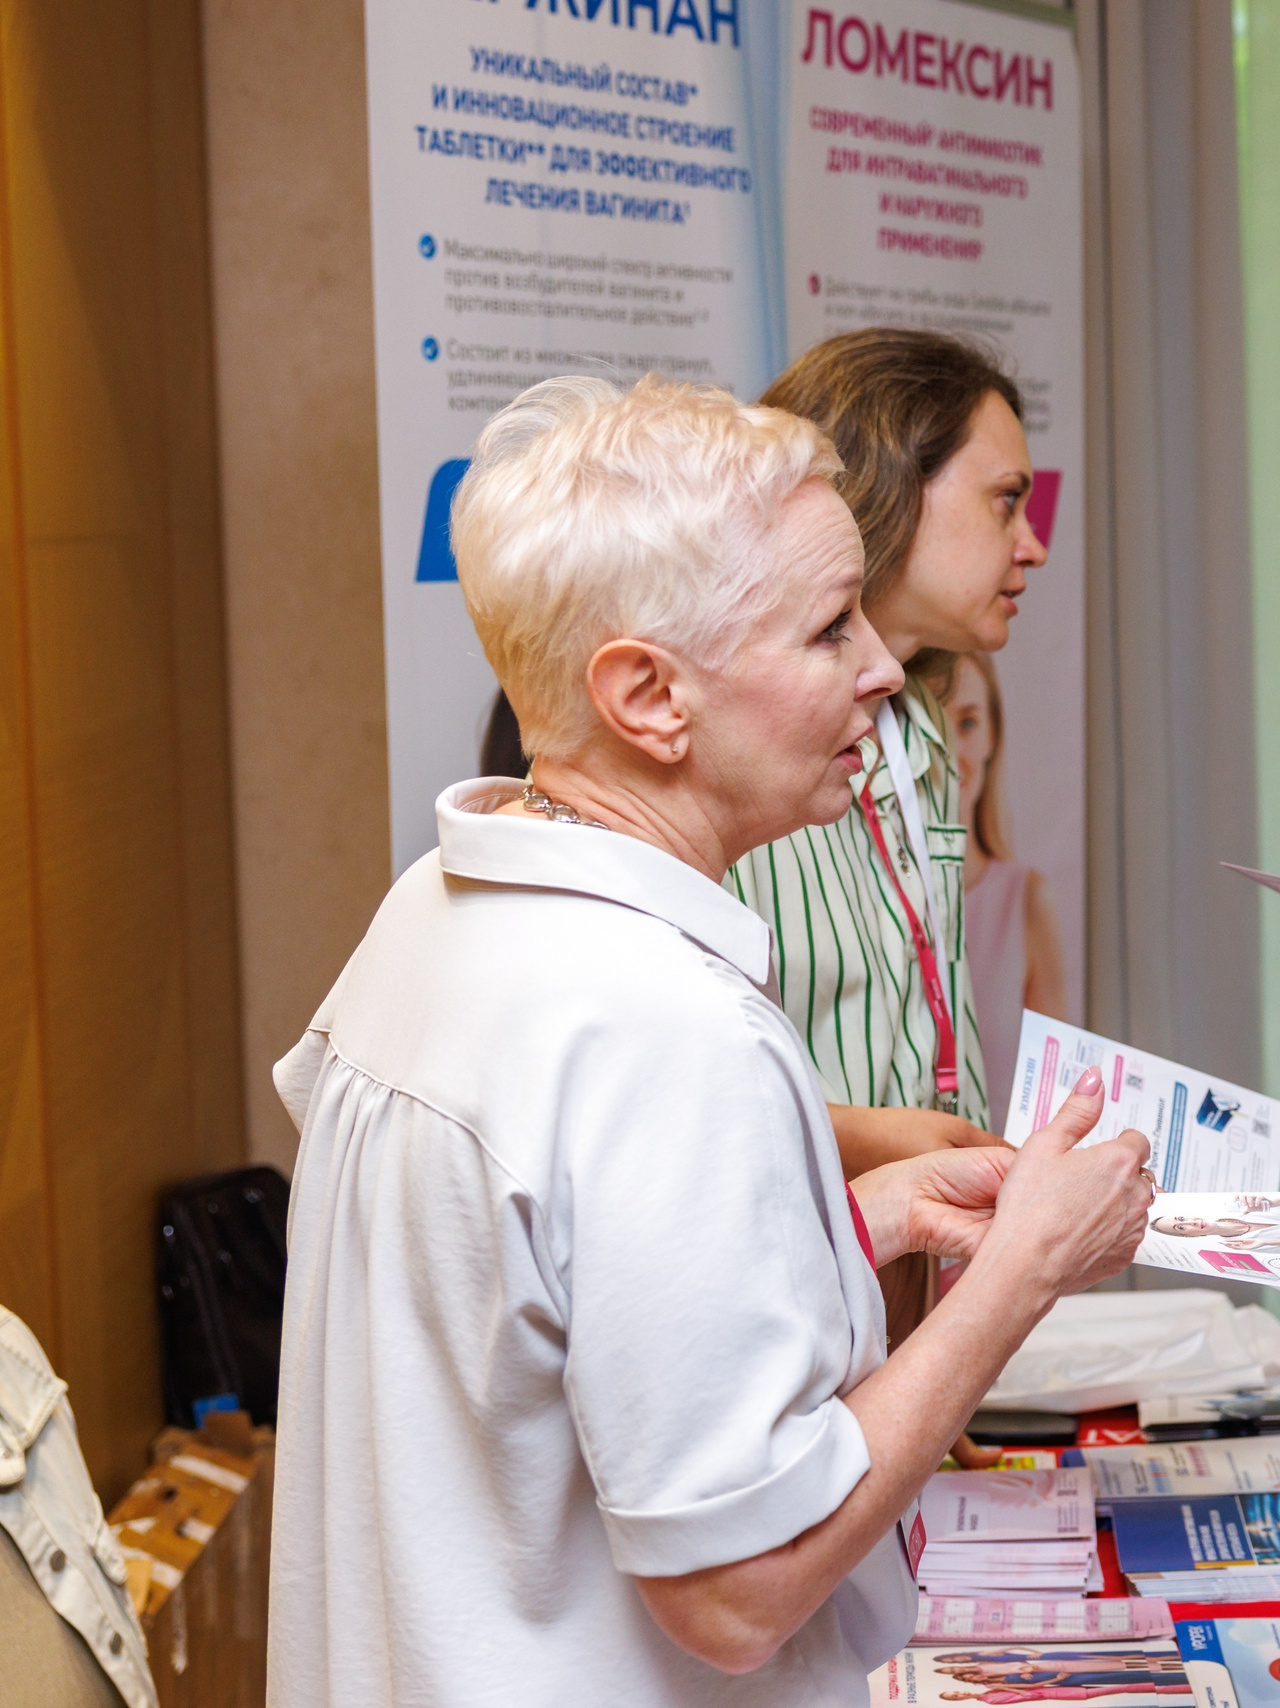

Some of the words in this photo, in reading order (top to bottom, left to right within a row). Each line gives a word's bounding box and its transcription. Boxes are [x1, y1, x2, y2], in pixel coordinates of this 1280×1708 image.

[470, 45, 613, 94] УНИКАЛЬНЫЙ
[801, 8, 1054, 112] ЛОМЕКСИН
[431, 83, 448, 111] И
[452, 88, 630, 139] ИННОВАЦИОННОЕ
[634, 114, 737, 153] СТРОЕНИЕ
[808, 104, 934, 148] СОВРЕМЕННЫЙ
[548, 143, 593, 173] ДЛЯ
[595, 150, 752, 194] ЭФФЕКТИВНОГО
[825, 145, 862, 173] ДЛЯ
[865, 153, 1030, 200] ИНТРАВАГИНАЛЬНОГО
[485, 177, 581, 214] ЛЕЧЕНИЯ
[877, 192, 891, 215] И
[895, 194, 985, 229] НАРУЖНОГО
[443, 237, 544, 266] Максимально
[876, 225, 984, 262] ПРИМЕНЕНИЯ
